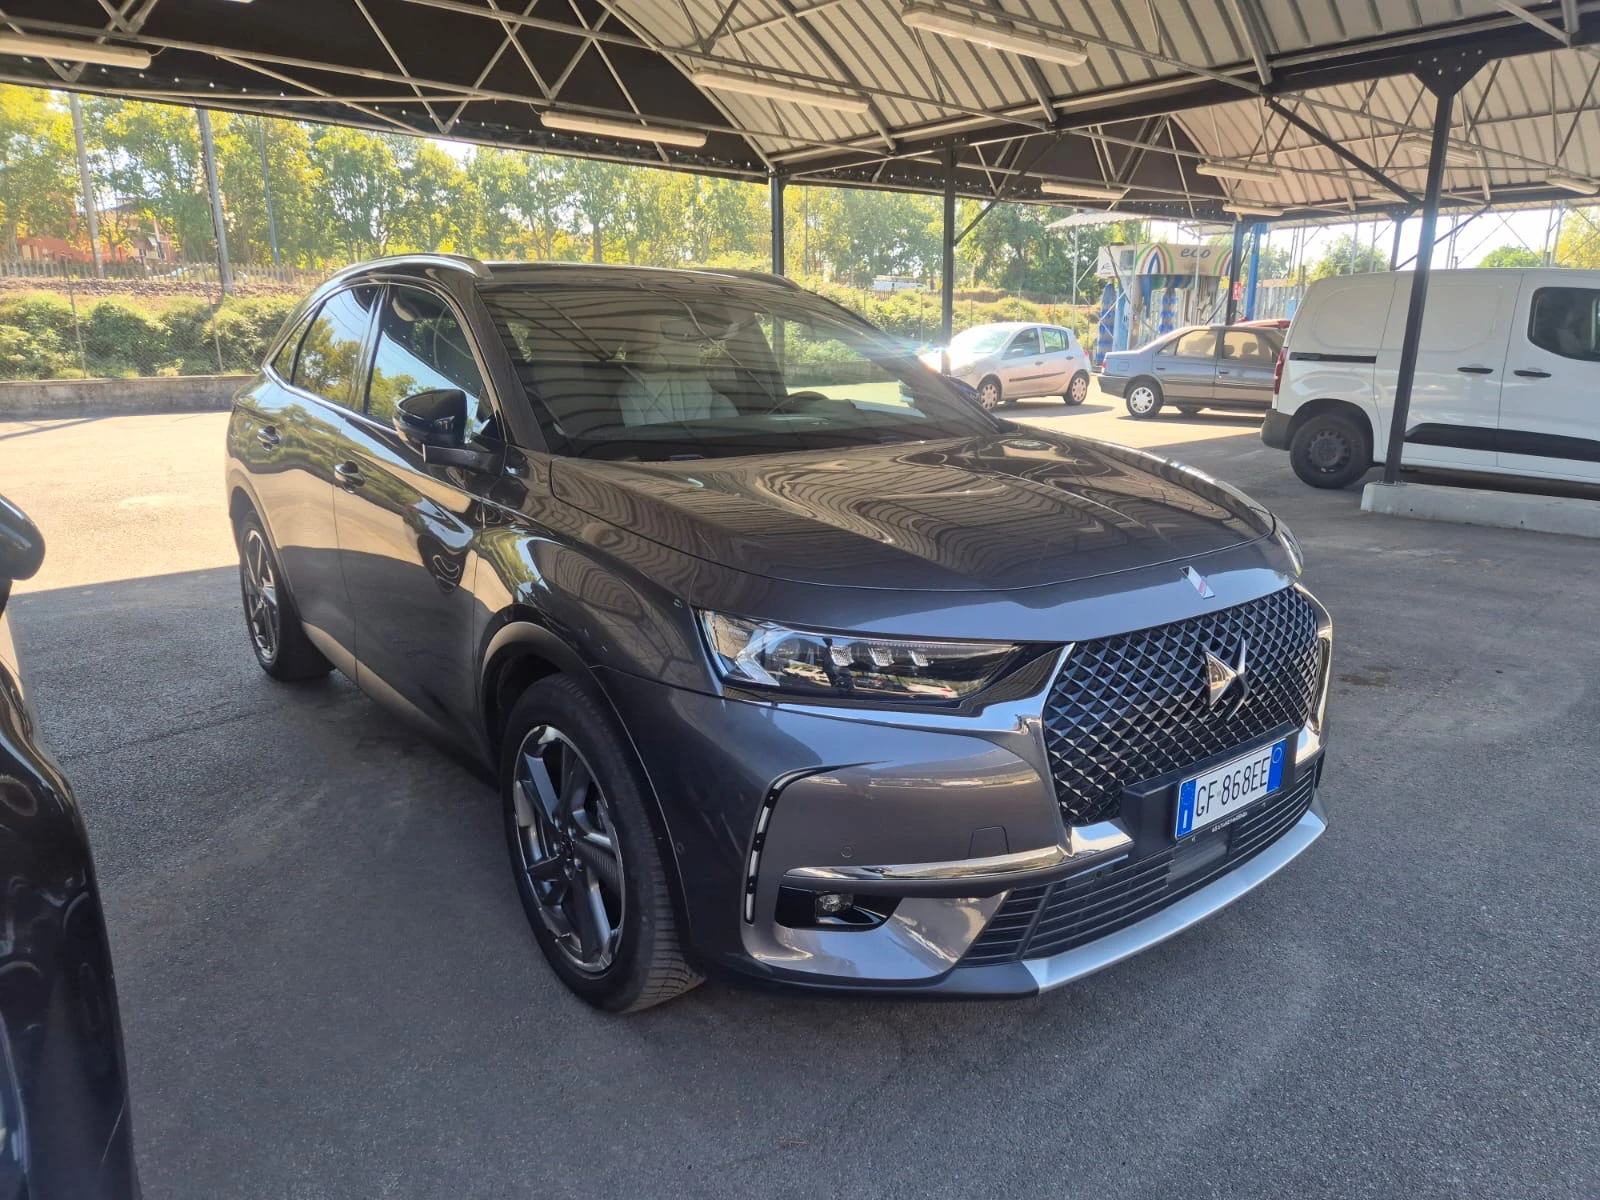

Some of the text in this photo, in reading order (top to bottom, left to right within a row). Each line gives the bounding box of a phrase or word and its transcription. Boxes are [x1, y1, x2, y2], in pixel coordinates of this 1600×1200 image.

[1180, 247, 1211, 259] eco
[1196, 756, 1271, 817] GF 868EE
[1182, 809, 1189, 829] I
